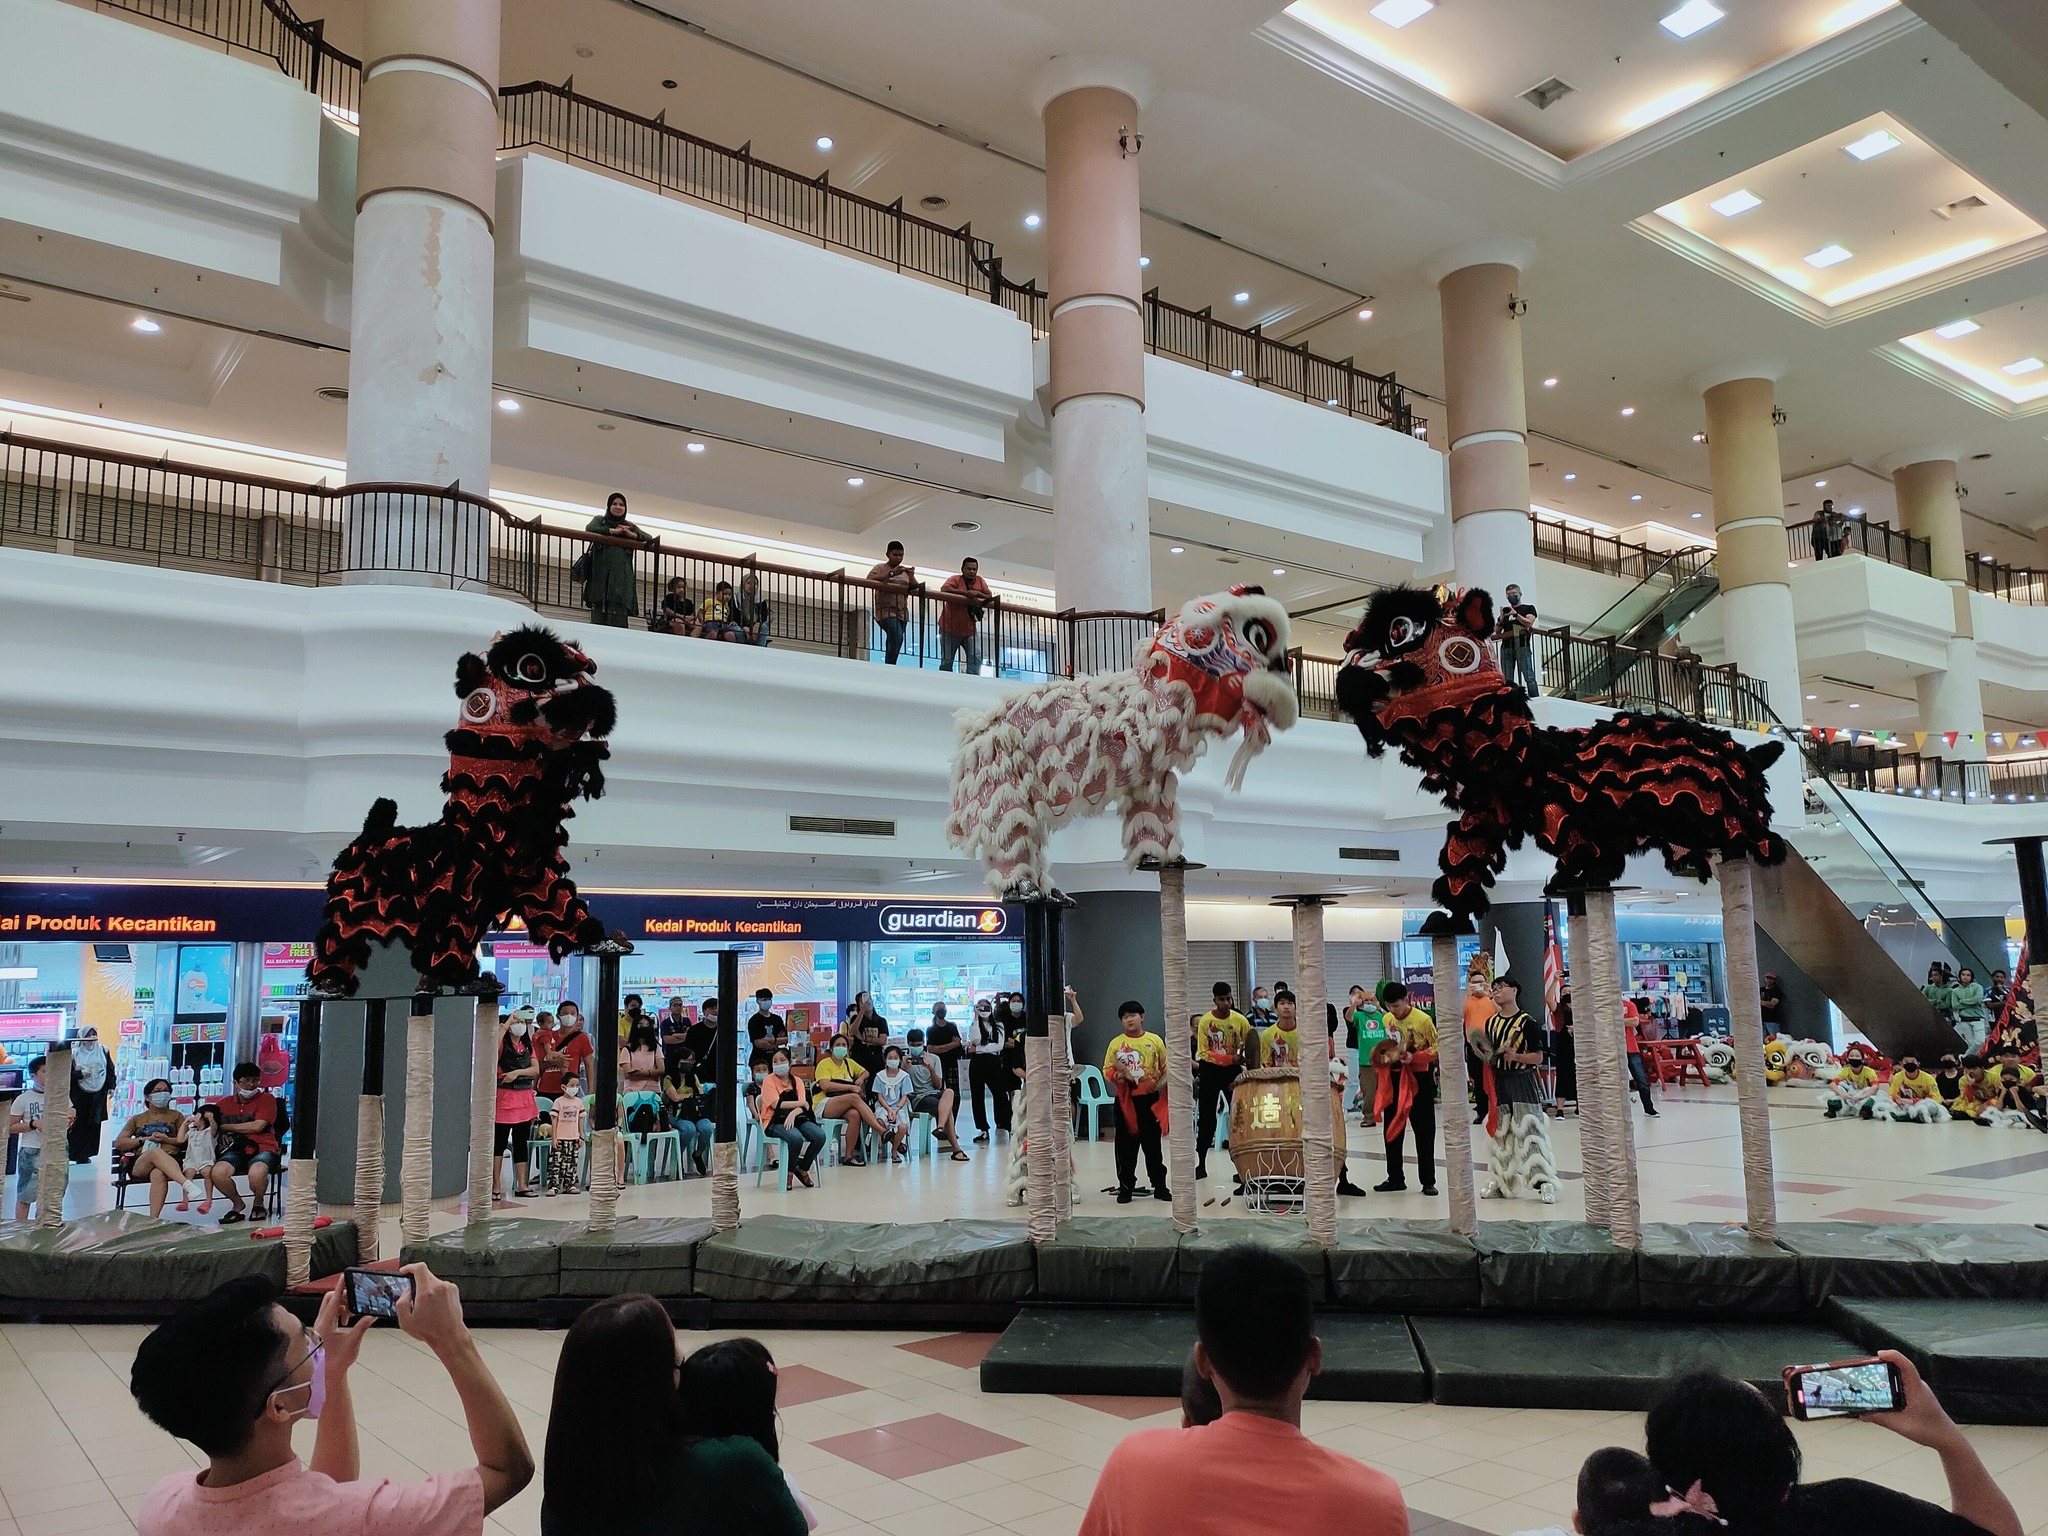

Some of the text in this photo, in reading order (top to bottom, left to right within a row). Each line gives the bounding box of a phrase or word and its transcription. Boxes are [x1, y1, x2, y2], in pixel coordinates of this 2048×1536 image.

[0, 914, 216, 932] ai Produk Kecantikan
[645, 918, 802, 933] Kedai Produk Kecantikan
[887, 910, 977, 932] guardian
[289, 949, 315, 957] FREE 1
